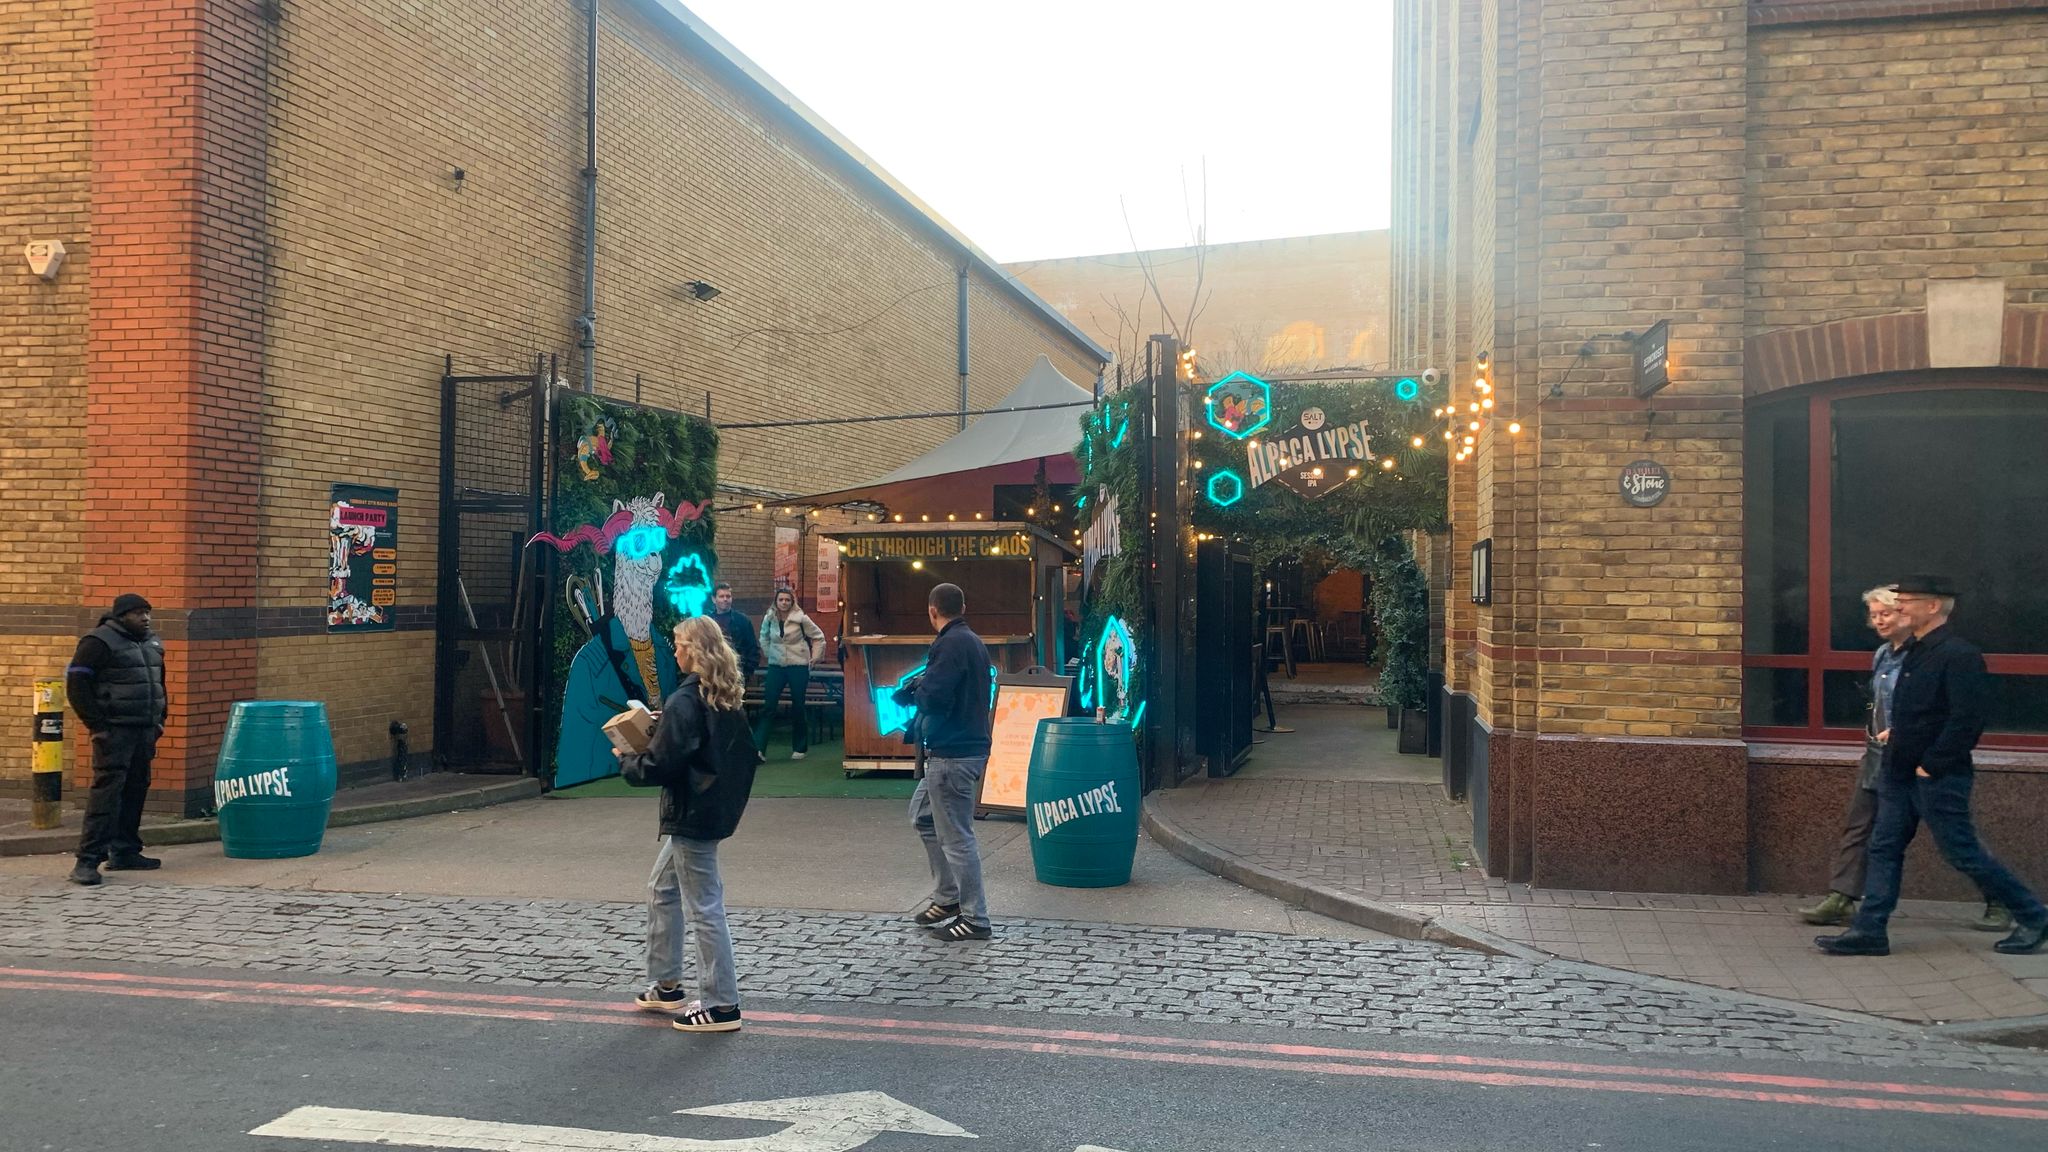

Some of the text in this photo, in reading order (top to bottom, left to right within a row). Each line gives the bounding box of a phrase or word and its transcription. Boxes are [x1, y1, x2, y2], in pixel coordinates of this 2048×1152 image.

[1303, 413, 1323, 421] SALT
[1247, 420, 1376, 489] ALPACA LYPSE
[1307, 479, 1318, 487] IPA
[1623, 474, 1665, 495] & Stone
[365, 513, 386, 523] PARTY
[847, 537, 872, 557] CUT
[872, 536, 946, 557] THROUGH
[951, 536, 976, 556] THE
[248, 766, 292, 798] LYPSE
[1034, 780, 1122, 839] ALPACA LYPSE
